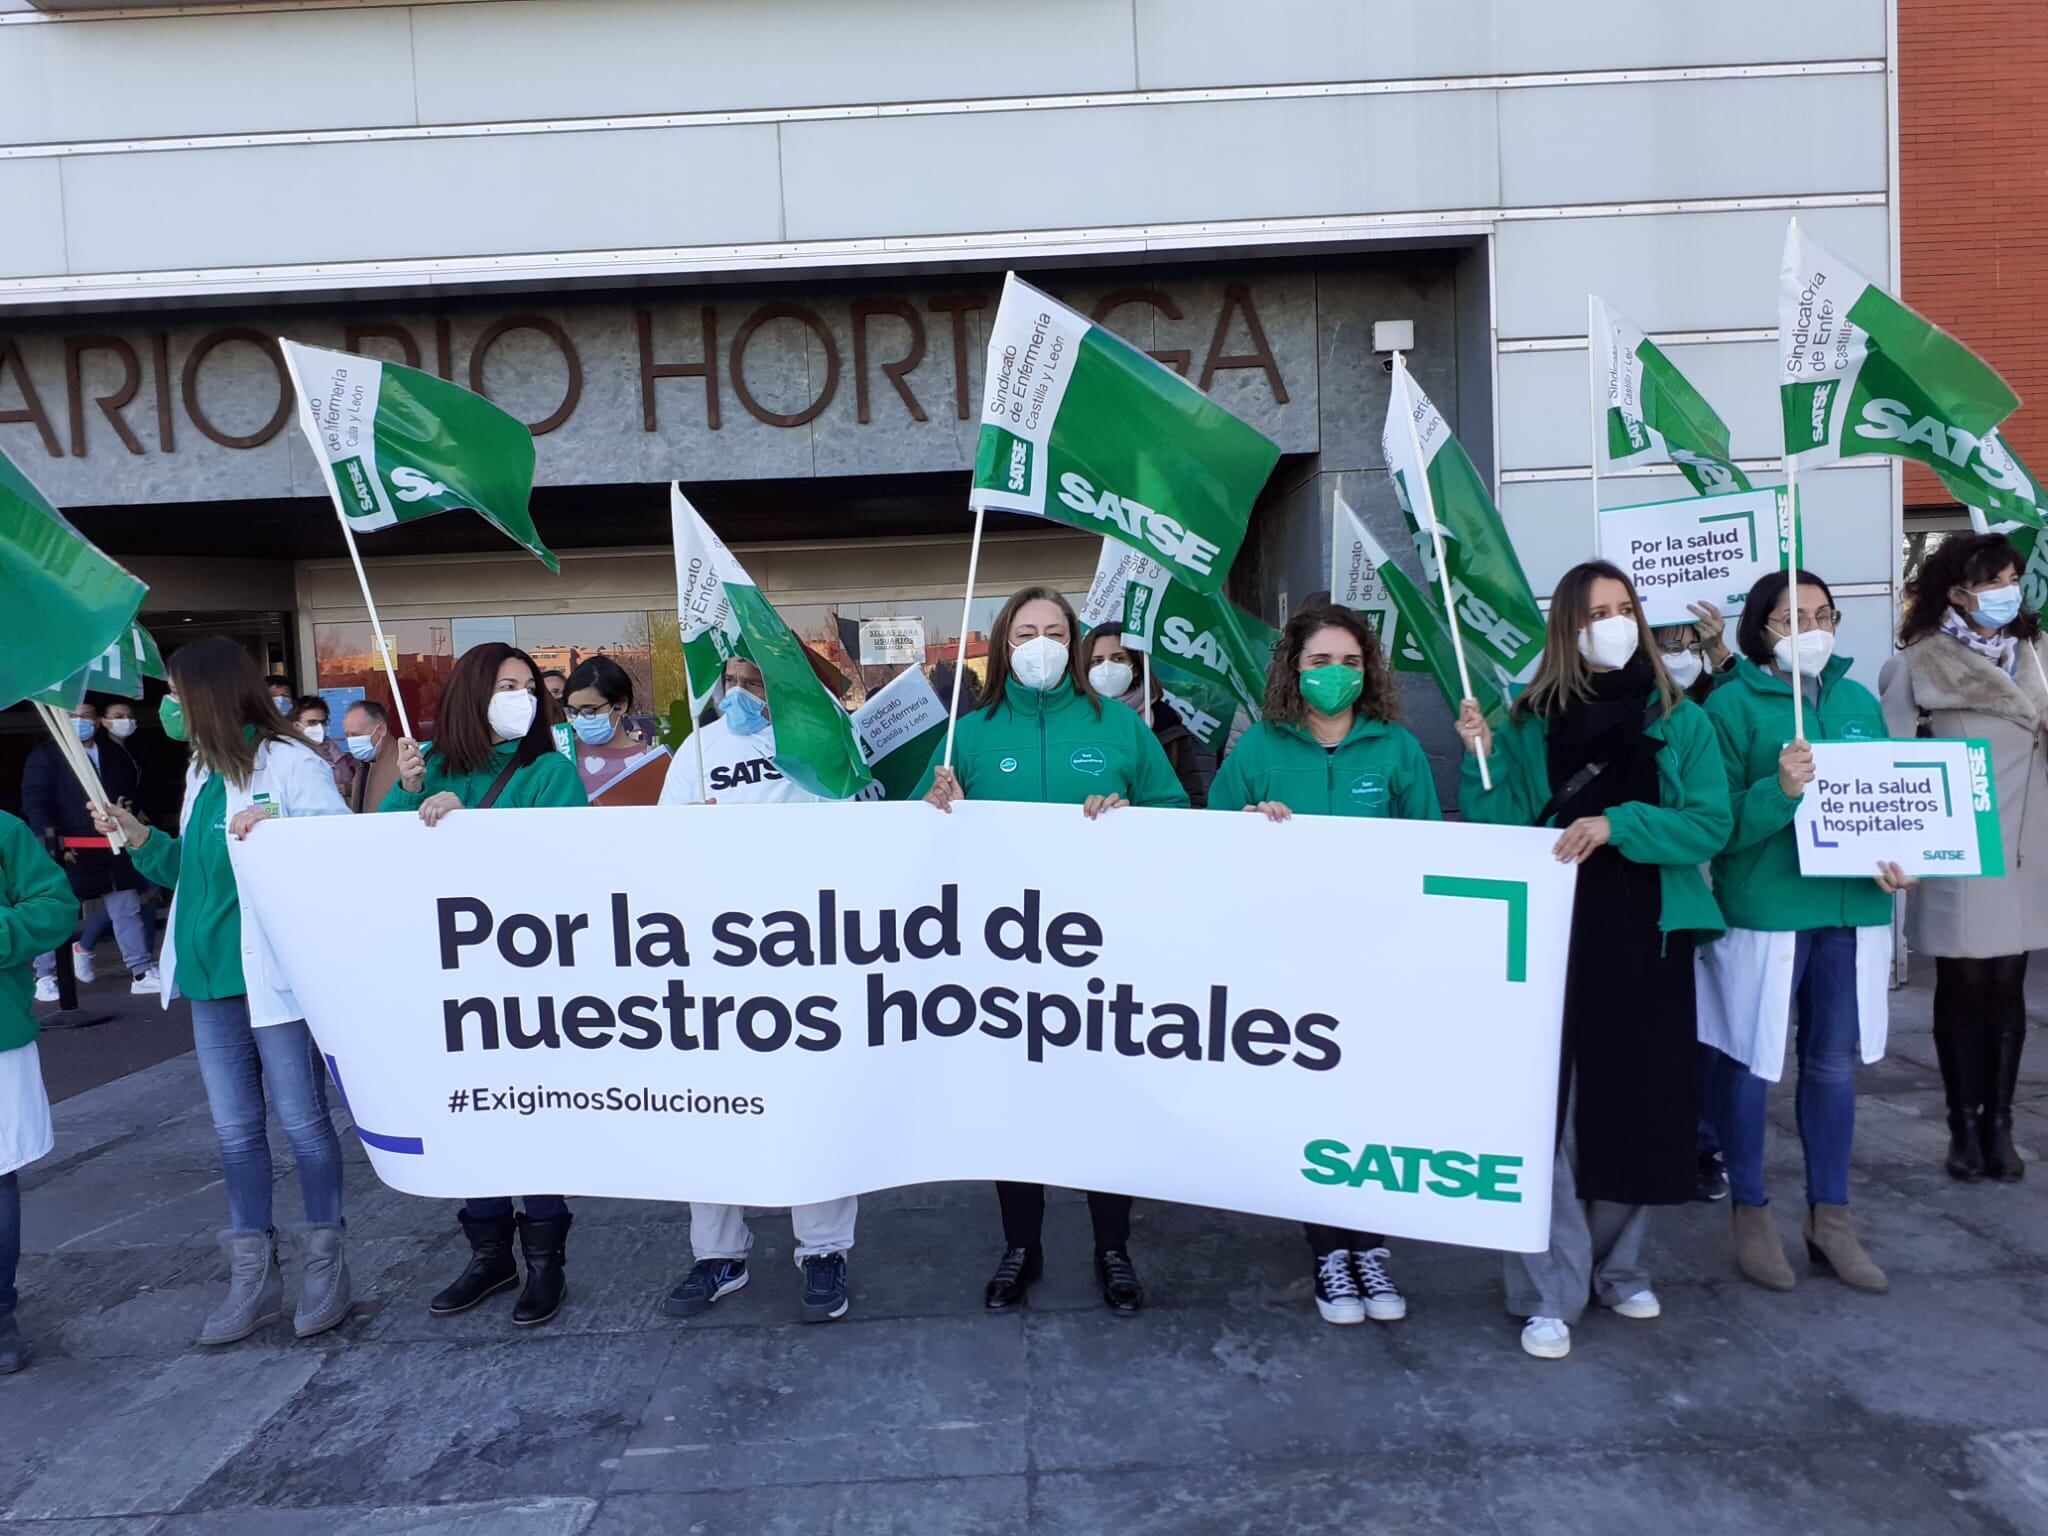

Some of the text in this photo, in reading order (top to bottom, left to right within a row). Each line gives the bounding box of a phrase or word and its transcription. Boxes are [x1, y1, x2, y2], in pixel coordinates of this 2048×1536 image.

[1787, 289, 1815, 373] Sindicato
[638, 282, 1289, 432] HORTGA
[1010, 312, 1051, 423] de Enfermería
[1808, 351, 1825, 372] de
[351, 384, 365, 413] León
[990, 344, 1017, 416] Sindicato
[1025, 335, 1064, 431] Castilla y León
[1811, 383, 1832, 442] SATSE
[328, 433, 341, 451] de
[1855, 398, 2018, 491] SATS
[346, 460, 373, 512] SATSE
[1008, 439, 1028, 492] SATSE
[1057, 472, 1221, 576] SATSE
[1631, 528, 1738, 554] Por la salud
[1347, 540, 1362, 601] Sindicato
[1632, 547, 1744, 571] de nuestros
[1633, 565, 1730, 589] hospitales
[1089, 609, 1101, 621] de
[1098, 554, 1132, 610] Enfermería
[1129, 586, 1148, 633] SATSE
[1362, 584, 1373, 601] de
[1104, 598, 1121, 623] astilla
[861, 697, 902, 729] Sindicato
[869, 696, 929, 739] de Enfermería
[876, 725, 904, 748] Castilla
[910, 712, 929, 727] León
[710, 756, 784, 790] SATS
[1818, 778, 1931, 795] Por la salud
[1968, 747, 1991, 812] SATSE
[1821, 797, 1938, 813] de nuestros
[1823, 815, 1924, 835] hospitales
[1922, 850, 1965, 860] SATSE
[436, 883, 1103, 970] Por la salud de
[443, 973, 1341, 1071] nuestros hospitales
[448, 1086, 765, 1116] #ExigimosSoluciones
[1300, 1139, 1523, 1203] SATSE
